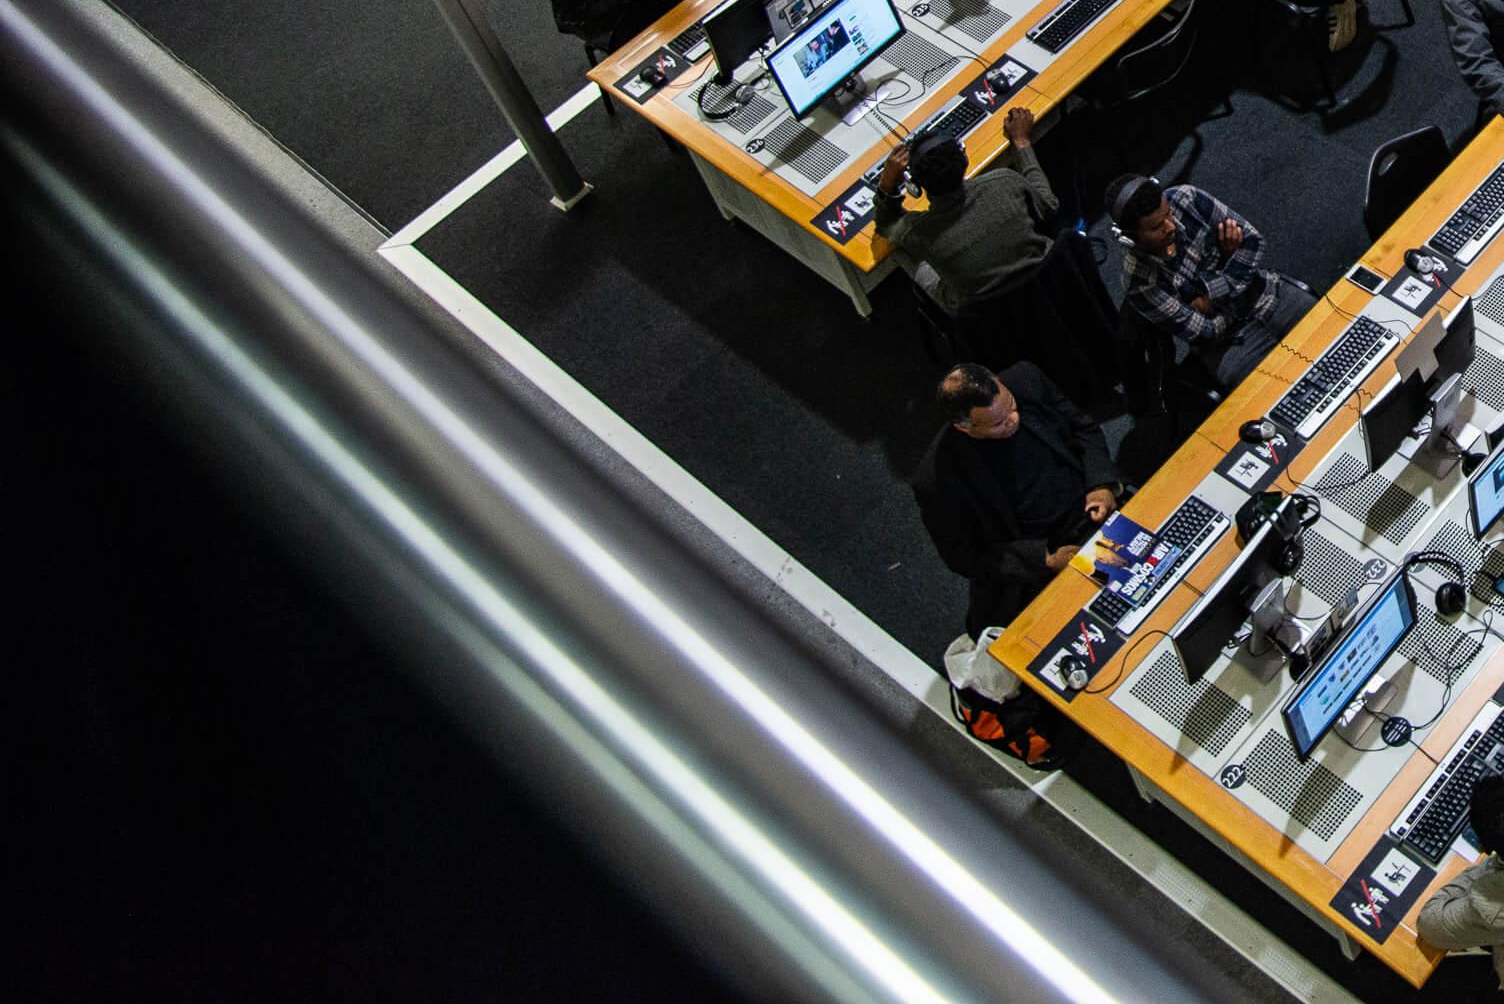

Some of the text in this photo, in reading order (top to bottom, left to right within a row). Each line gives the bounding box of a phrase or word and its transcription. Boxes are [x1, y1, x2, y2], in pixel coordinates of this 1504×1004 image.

[745, 138, 765, 154] 236
[1366, 559, 1386, 578] 232
[1121, 562, 1154, 596] COSMOS
[1223, 766, 1243, 787] 222
